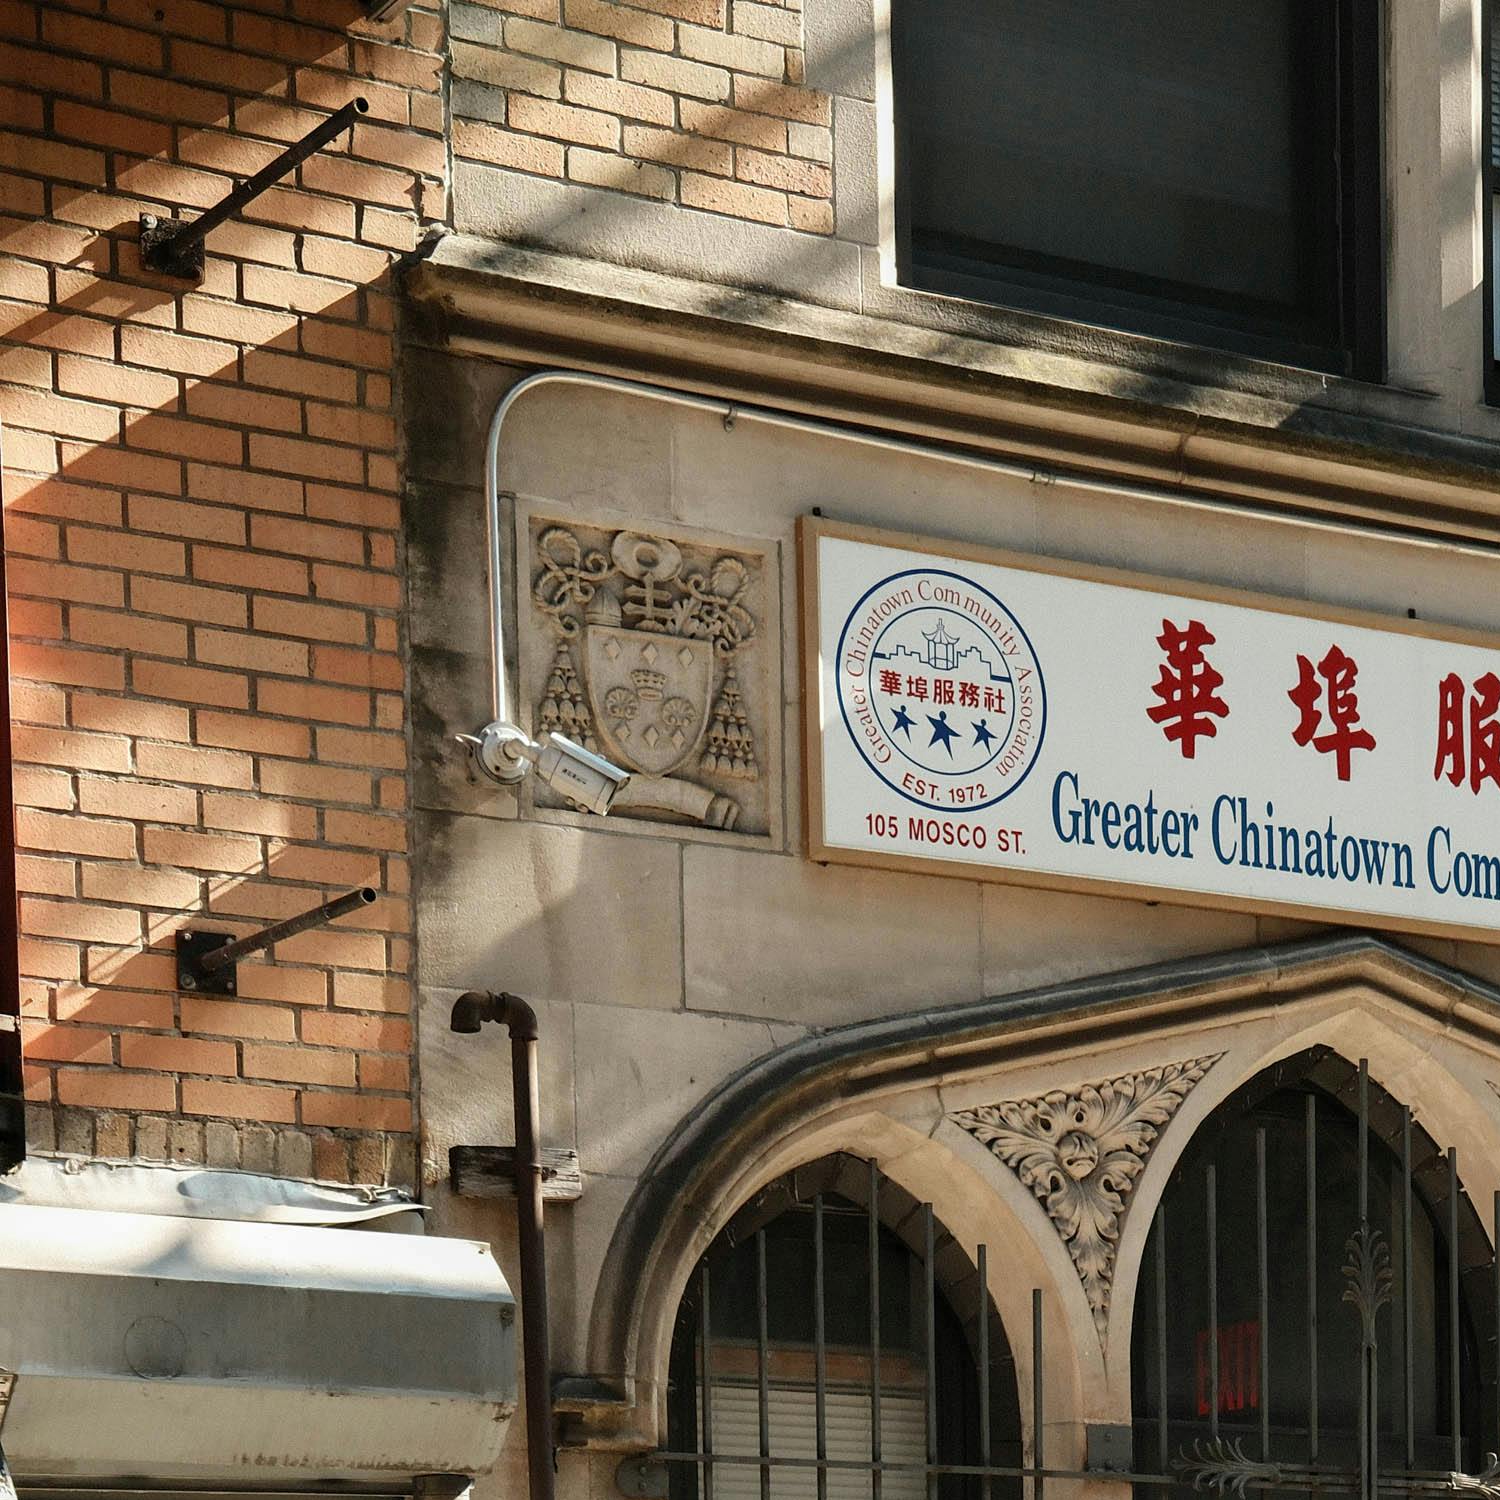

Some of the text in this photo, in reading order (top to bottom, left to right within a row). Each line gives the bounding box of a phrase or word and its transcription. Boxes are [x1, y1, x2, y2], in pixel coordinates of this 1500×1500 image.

[846, 580, 1033, 777] Greater Chinatown Community Association
[879, 669, 1007, 715] 華埠服務社
[902, 772, 988, 804] EST. 1972
[865, 813, 1026, 854] 105 MOSCO ST.
[1052, 771, 1199, 858] Greater
[1211, 794, 1415, 888] Chinatown
[1196, 1322, 1260, 1416] EXIT
